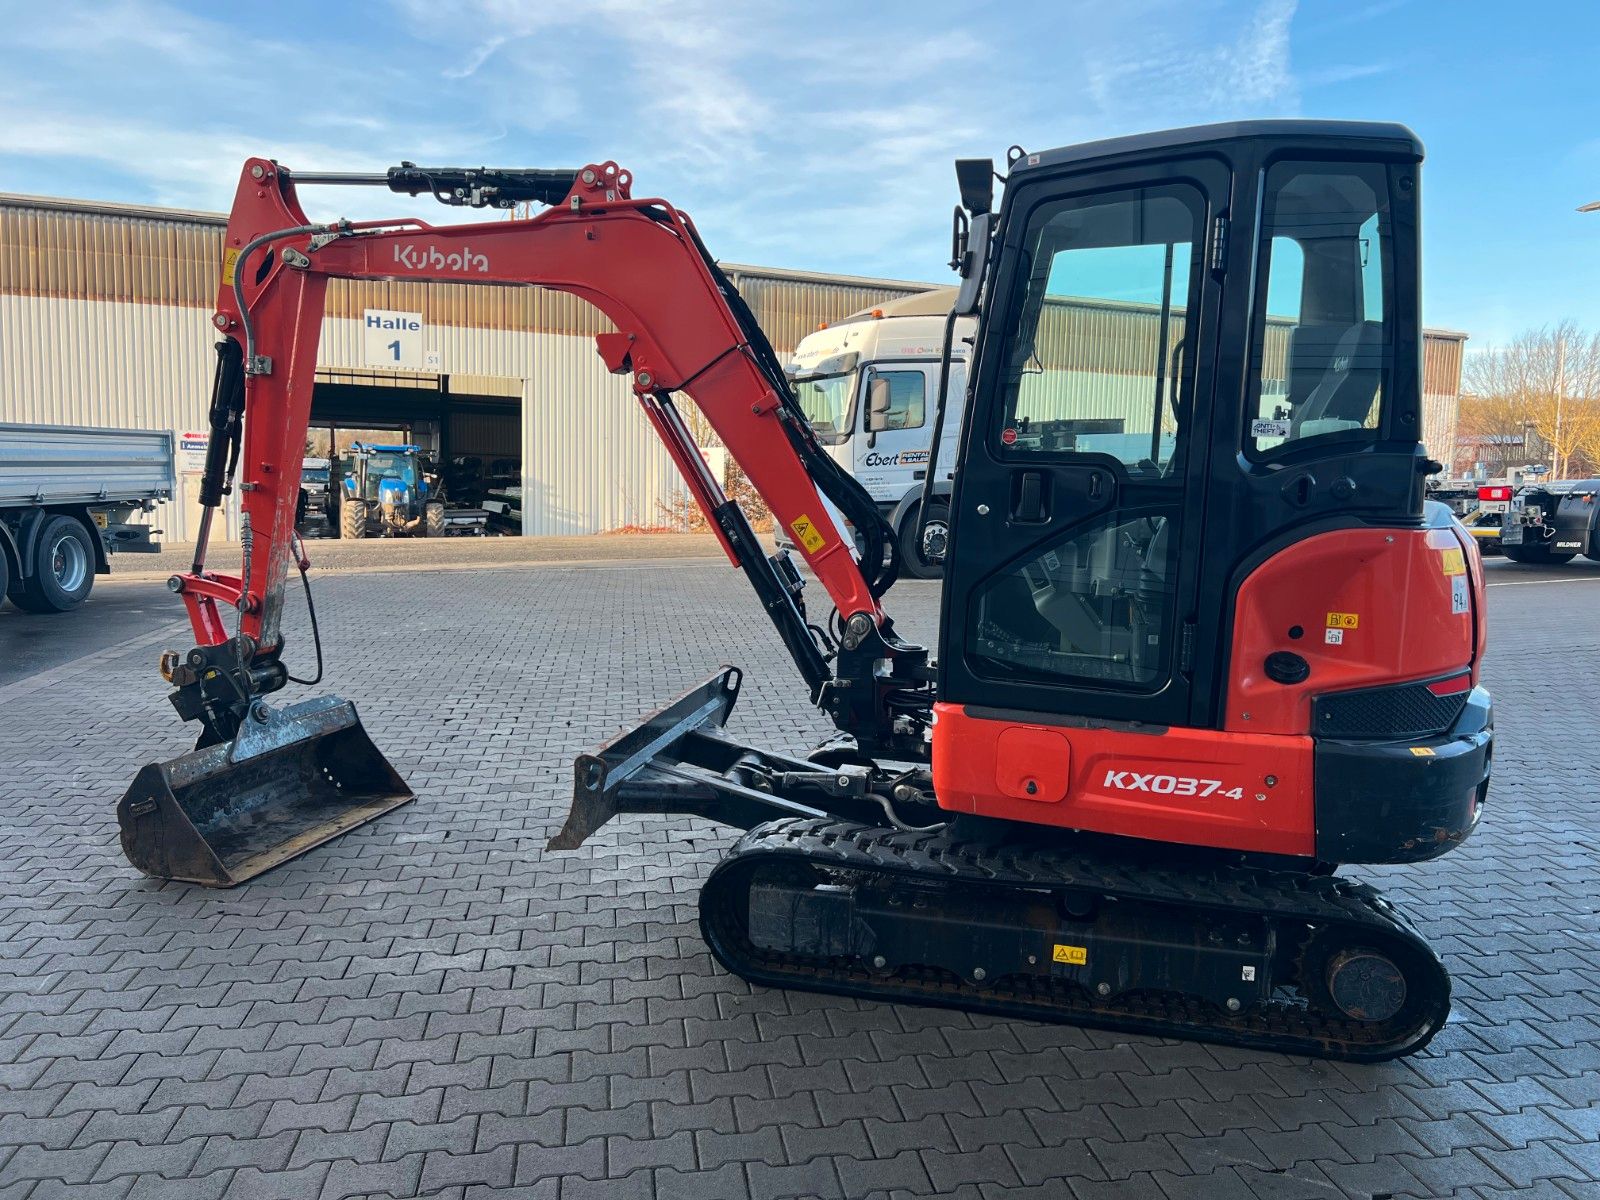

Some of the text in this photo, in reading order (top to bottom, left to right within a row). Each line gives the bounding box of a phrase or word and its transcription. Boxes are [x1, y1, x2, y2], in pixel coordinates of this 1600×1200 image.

[394, 244, 489, 272] Kubota
[366, 315, 420, 331] Halle
[387, 340, 401, 361] 1
[865, 452, 899, 467] Ebert
[1103, 770, 1244, 800] KX037-4
